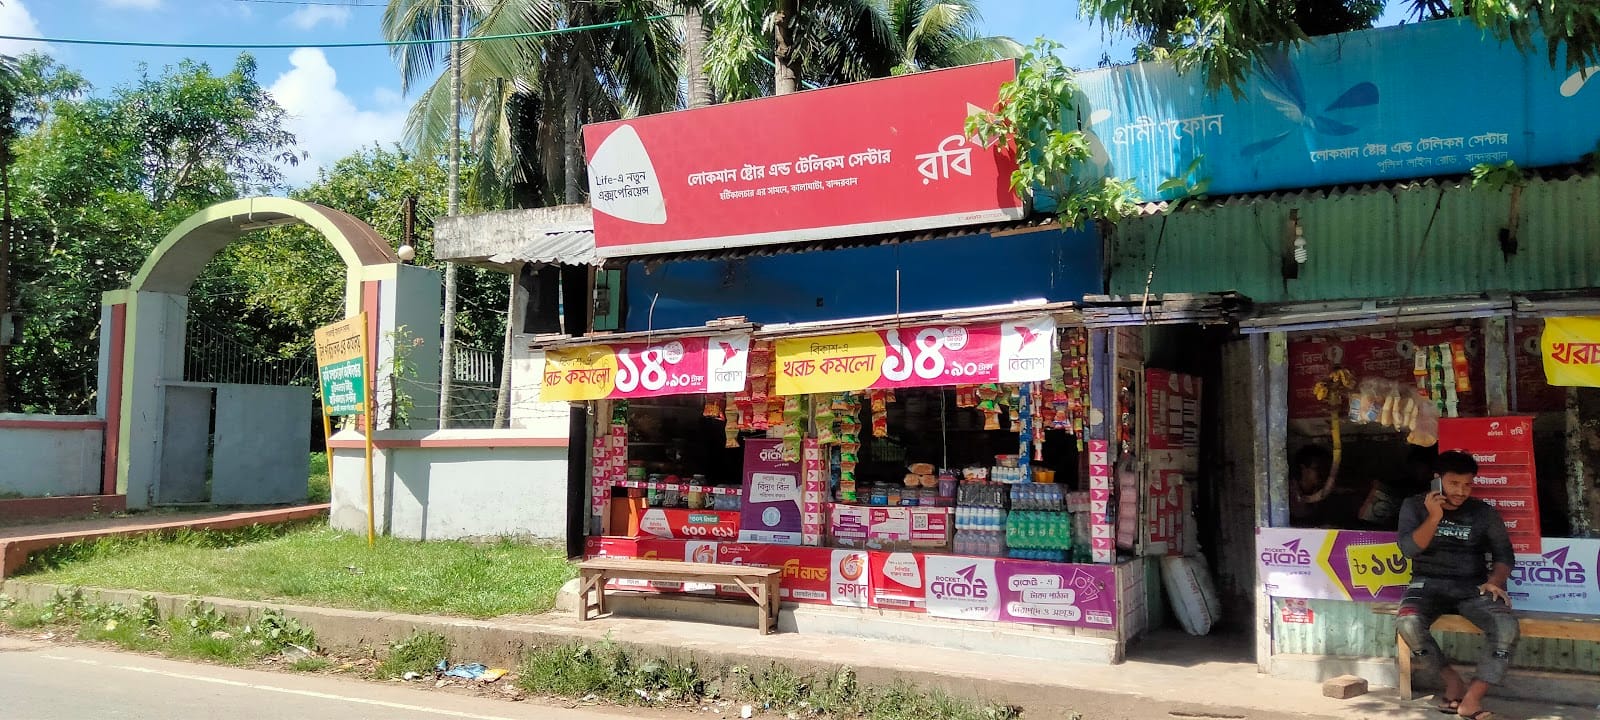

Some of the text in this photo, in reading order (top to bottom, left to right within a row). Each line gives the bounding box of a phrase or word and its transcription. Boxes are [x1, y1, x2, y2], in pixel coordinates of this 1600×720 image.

[1310, 146, 1359, 162] লোকমান
[1416, 136, 1464, 153] টেলিকম
[1468, 131, 1508, 147] সেন্টার
[687, 168, 737, 186] লোকমান
[768, 162, 792, 177] এন্ড
[795, 154, 844, 173] টেলিকম
[848, 148, 891, 165] সেন্টার
[915, 134, 972, 185] রবি
[626, 171, 646, 184] নতুন
[784, 354, 876, 377] খরচ কমলো
[1009, 353, 1045, 371] বিকাশ
[545, 367, 611, 387] রচ কমলো
[1510, 427, 1523, 435] রবি
[682, 525, 706, 536] ৫০০
[1261, 549, 1311, 566] রকেট
[800, 566, 828, 581] লাভ
[1013, 578, 1038, 586] রকেট
[1508, 562, 1585, 586] রকেট
[837, 582, 868, 600] নগদ
[931, 579, 988, 599] রকেট
